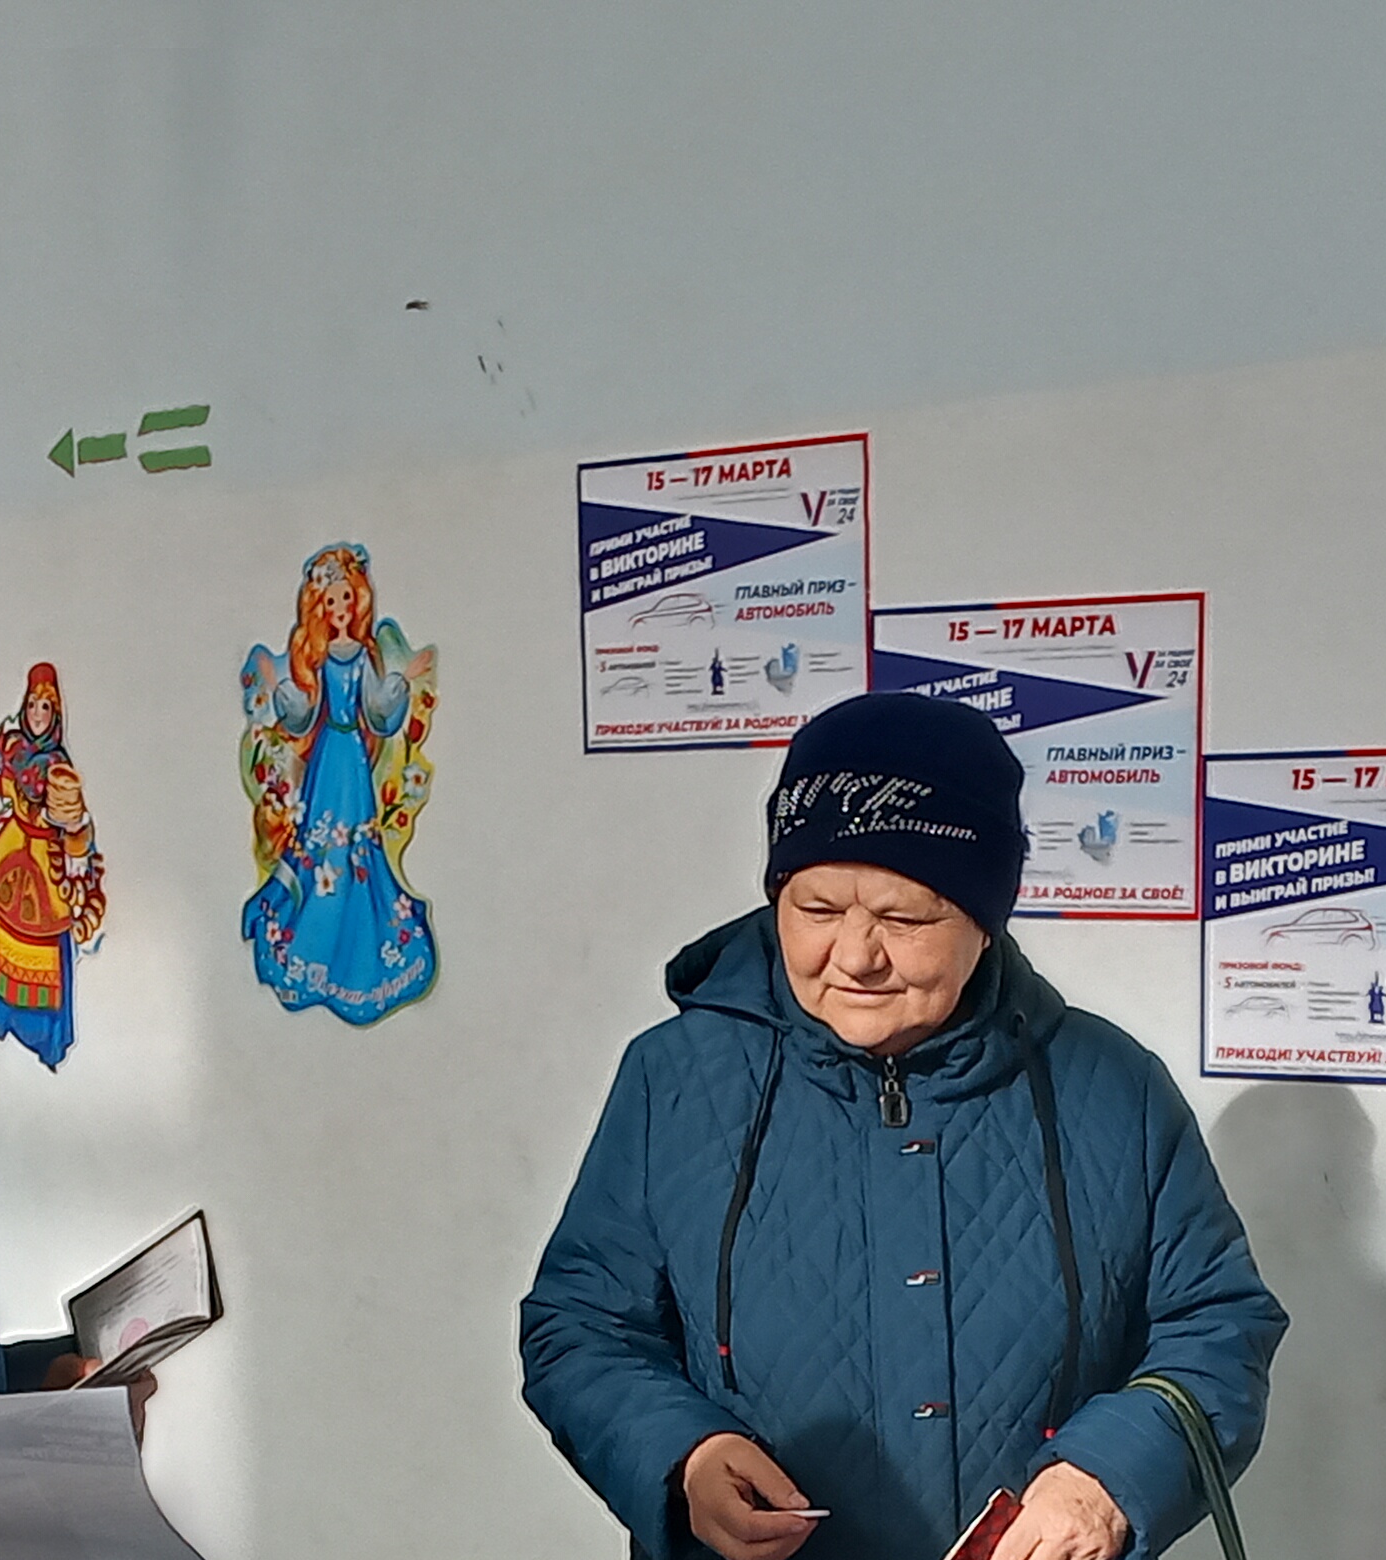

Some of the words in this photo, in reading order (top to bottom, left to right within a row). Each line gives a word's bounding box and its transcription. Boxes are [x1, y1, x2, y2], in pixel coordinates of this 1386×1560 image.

[646, 471, 665, 491] 15
[693, 466, 714, 487] 17
[718, 458, 792, 482] МАРТА
[836, 507, 856, 524] 24
[634, 514, 692, 543] УЧАСТИЕ
[600, 530, 706, 579] ВИКТОРИНЕ
[734, 580, 805, 601] ГЛАВНЫЙ
[807, 579, 845, 596] ПРИЗ
[734, 602, 835, 622] АВТОМОБИЛЬ
[947, 621, 970, 641] 15
[1002, 619, 1025, 639] 17
[1030, 614, 1117, 638] МАРТА
[933, 670, 999, 696] УЧАСТИЕ
[1165, 670, 1189, 688] 24
[724, 717, 741, 731] ЗА
[1046, 744, 1126, 762] ГЛАВНЫЙ
[1128, 745, 1175, 761] ПРИЗ
[1045, 768, 1162, 784] АВТОМОБИЛЬ
[1290, 768, 1316, 791] 15
[1353, 767, 1380, 790] 17
[1215, 834, 1273, 859] ПРИМИ
[1274, 820, 1349, 848] УЧАСТИЕ
[1229, 839, 1366, 884] ВИКТОРИНЕ
[1030, 886, 1050, 899] ЗА
[1053, 886, 1117, 901] РОДНОЕ!
[1118, 887, 1138, 900] ЗА
[1141, 884, 1186, 901] СВОЁ!
[1214, 895, 1227, 911] И
[1229, 876, 1309, 908] ВЫИГРАЙ
[1215, 1046, 1292, 1063] ПРИХОДИ!
[1295, 1046, 1382, 1065] УЧАСТВУЙ!
